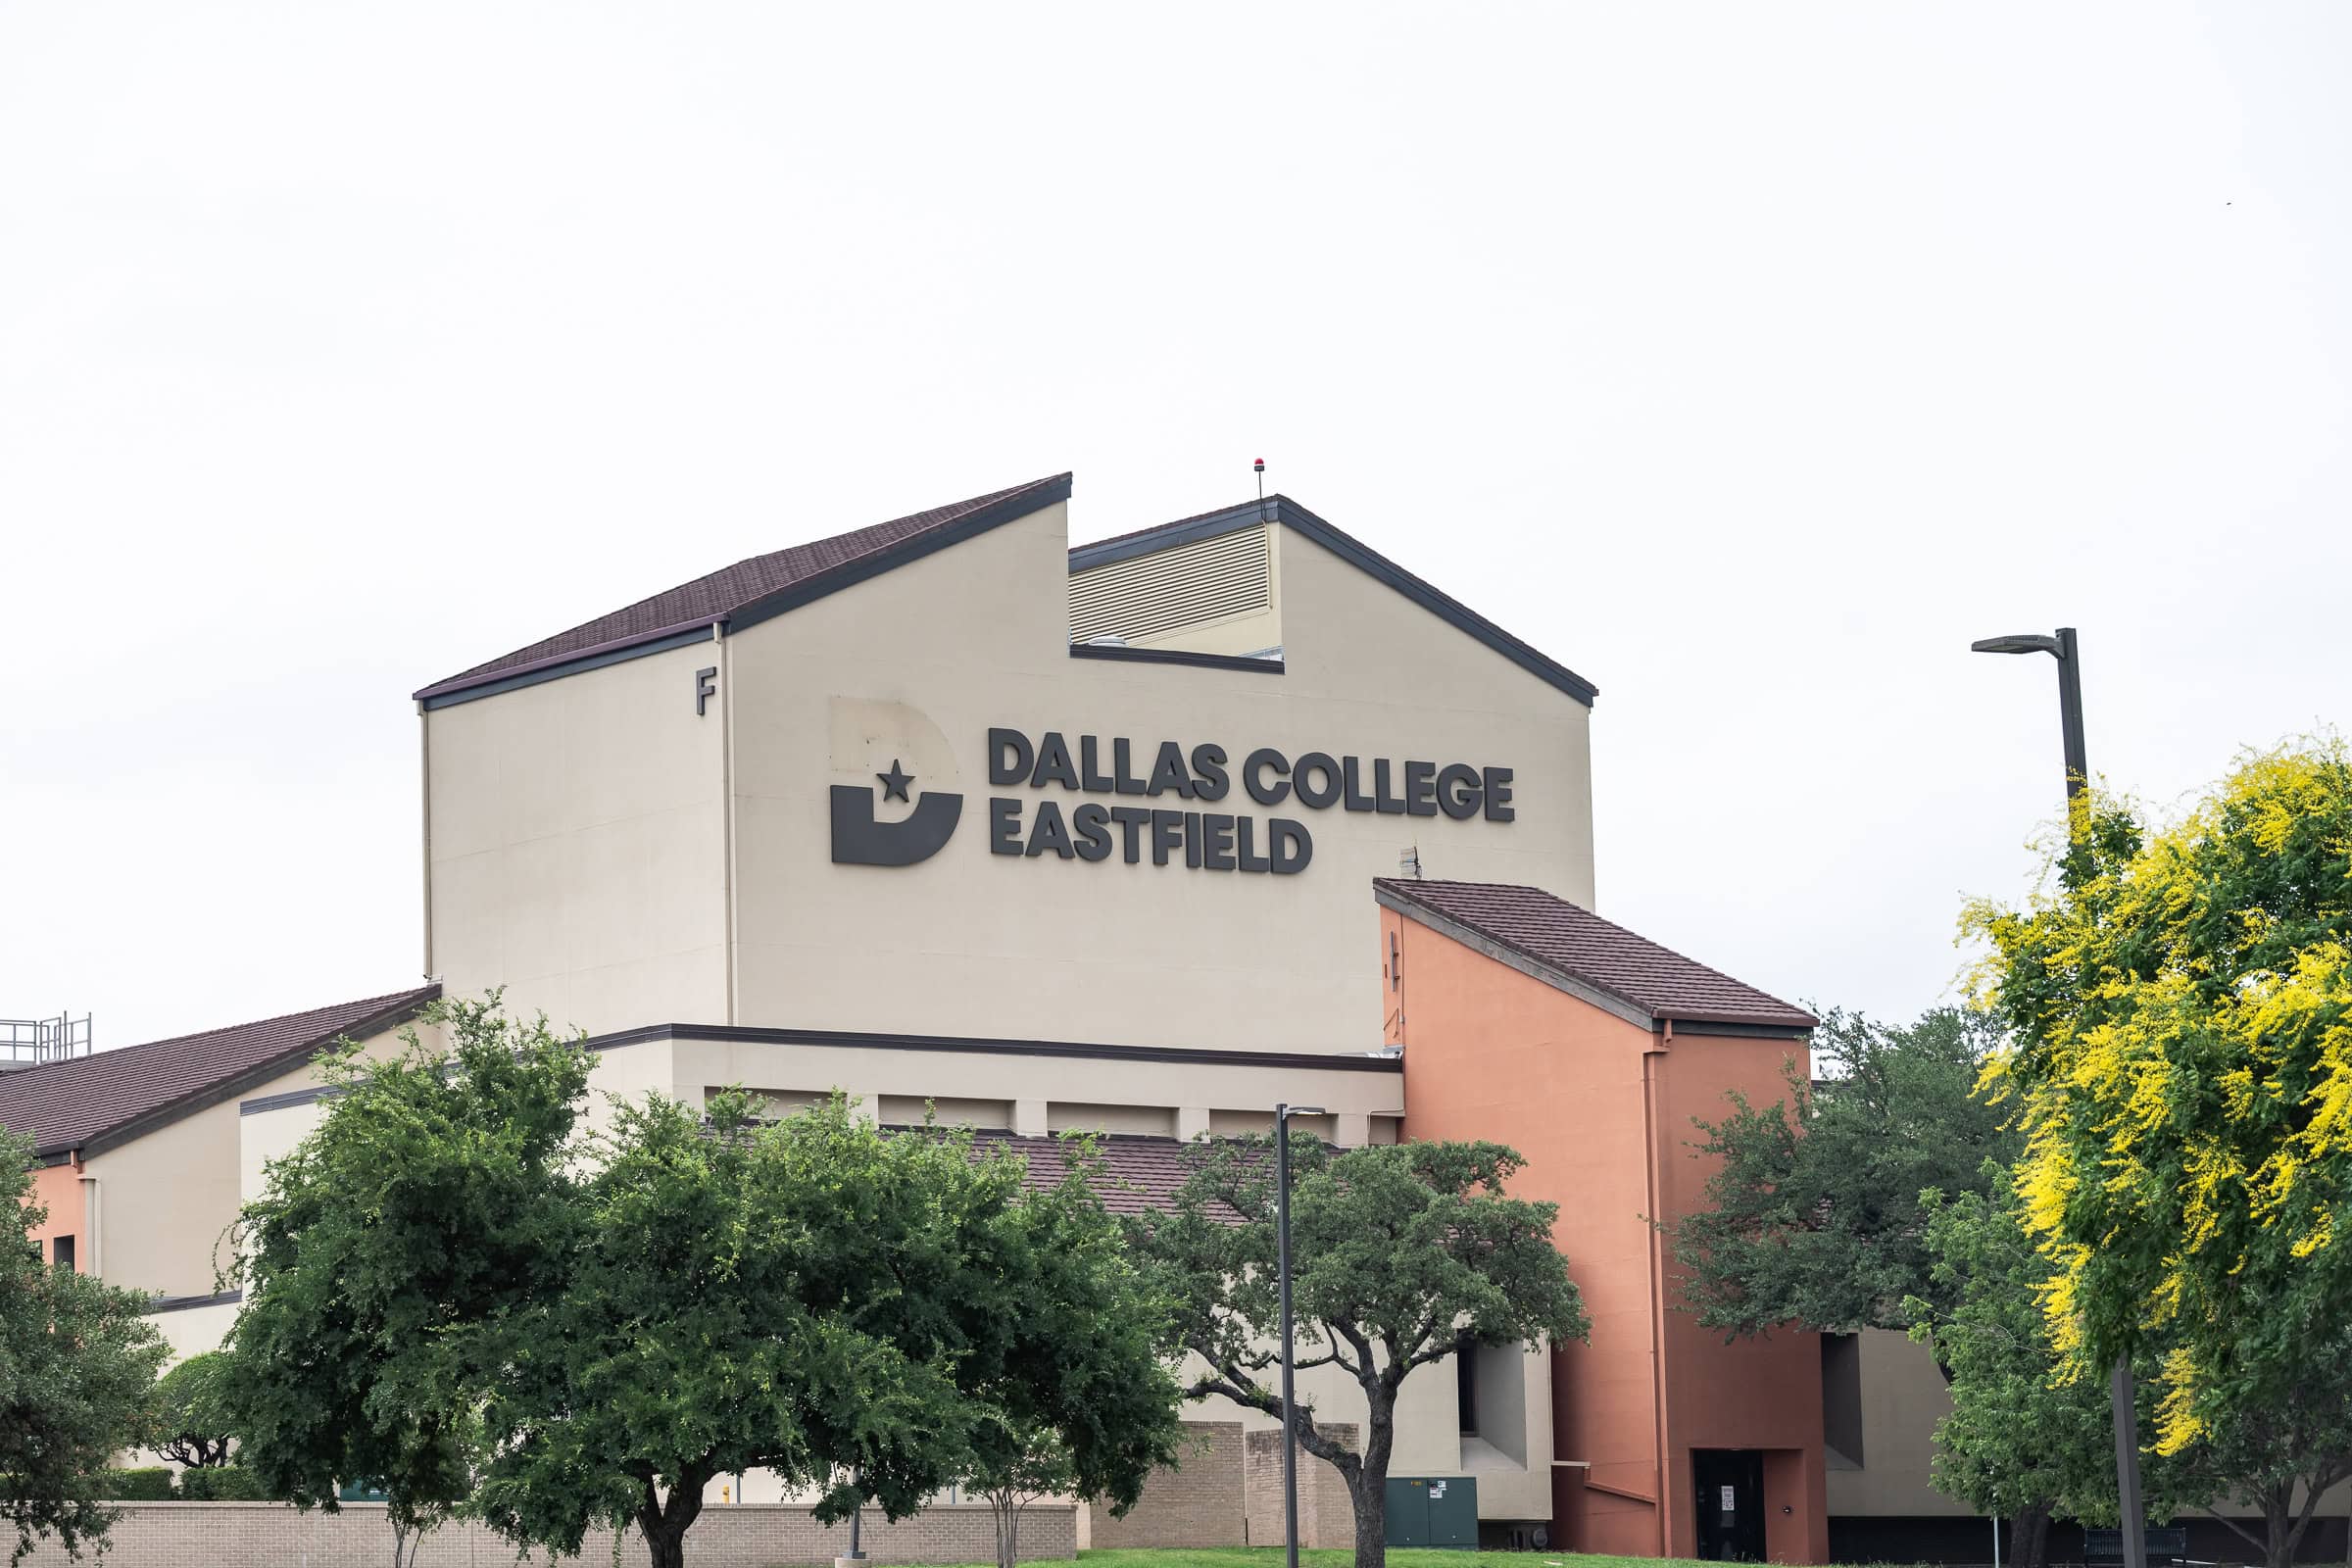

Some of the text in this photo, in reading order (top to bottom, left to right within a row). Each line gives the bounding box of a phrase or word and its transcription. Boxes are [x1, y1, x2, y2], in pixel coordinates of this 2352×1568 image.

[696, 665, 717, 716] F
[988, 727, 1515, 824] DALLAS COLLEGE
[990, 797, 1313, 876] EASTFIELD
